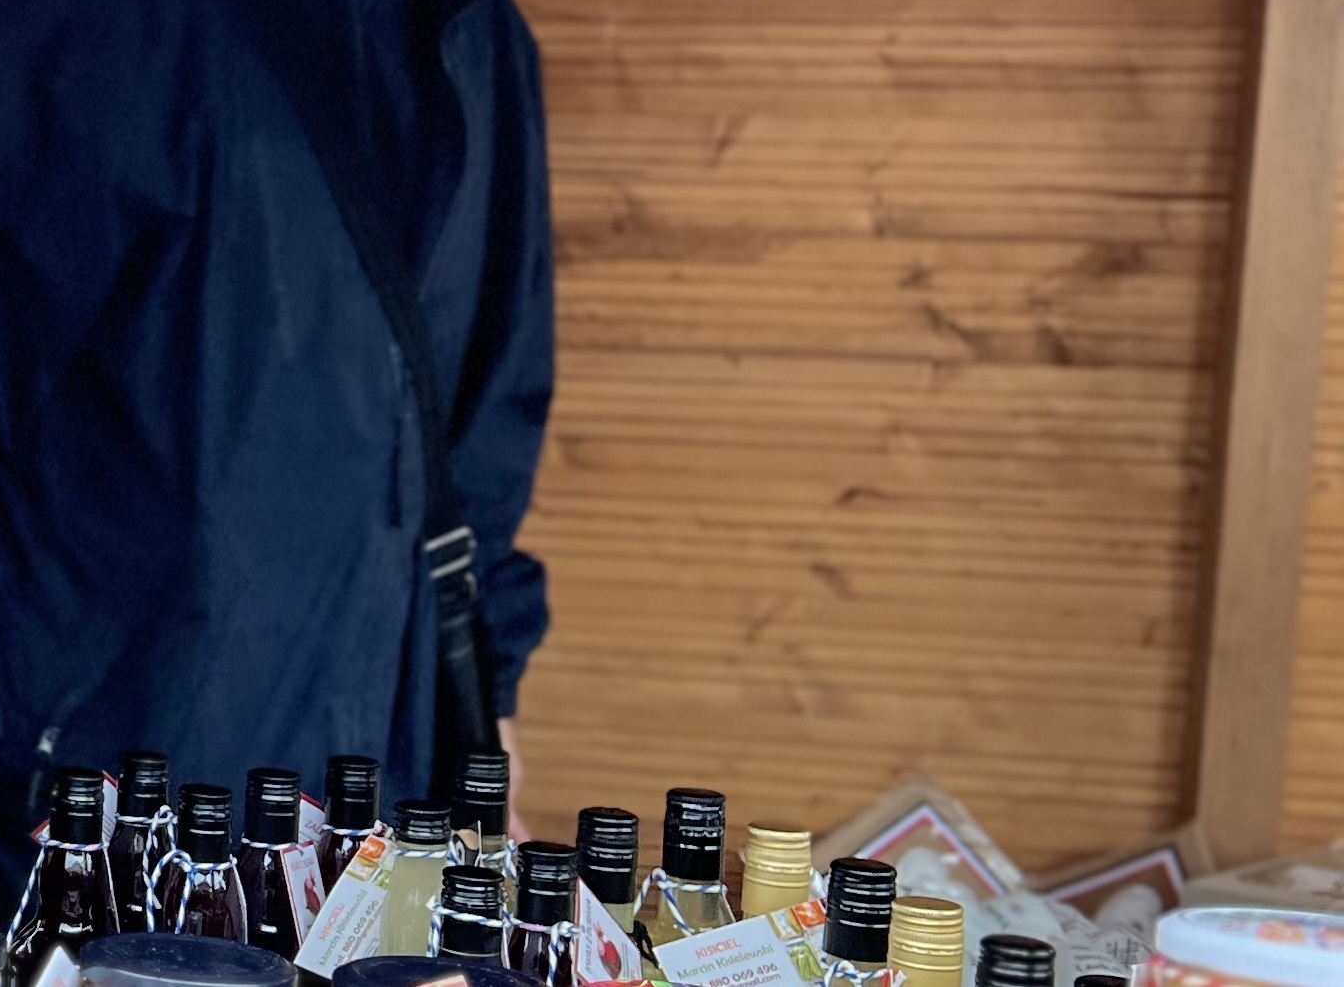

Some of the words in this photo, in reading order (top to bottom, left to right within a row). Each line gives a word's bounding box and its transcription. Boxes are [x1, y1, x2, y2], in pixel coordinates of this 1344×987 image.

[319, 903, 344, 941] KISICIEL
[353, 916, 367, 934] 069
[364, 898, 379, 917] 496
[317, 934, 341, 966] Marcin
[677, 959, 715, 981] Marcin
[715, 941, 774, 969] Kisielewski
[695, 936, 741, 960] KISICIEL
[733, 969, 753, 981] 069
[757, 963, 778, 975] 496
